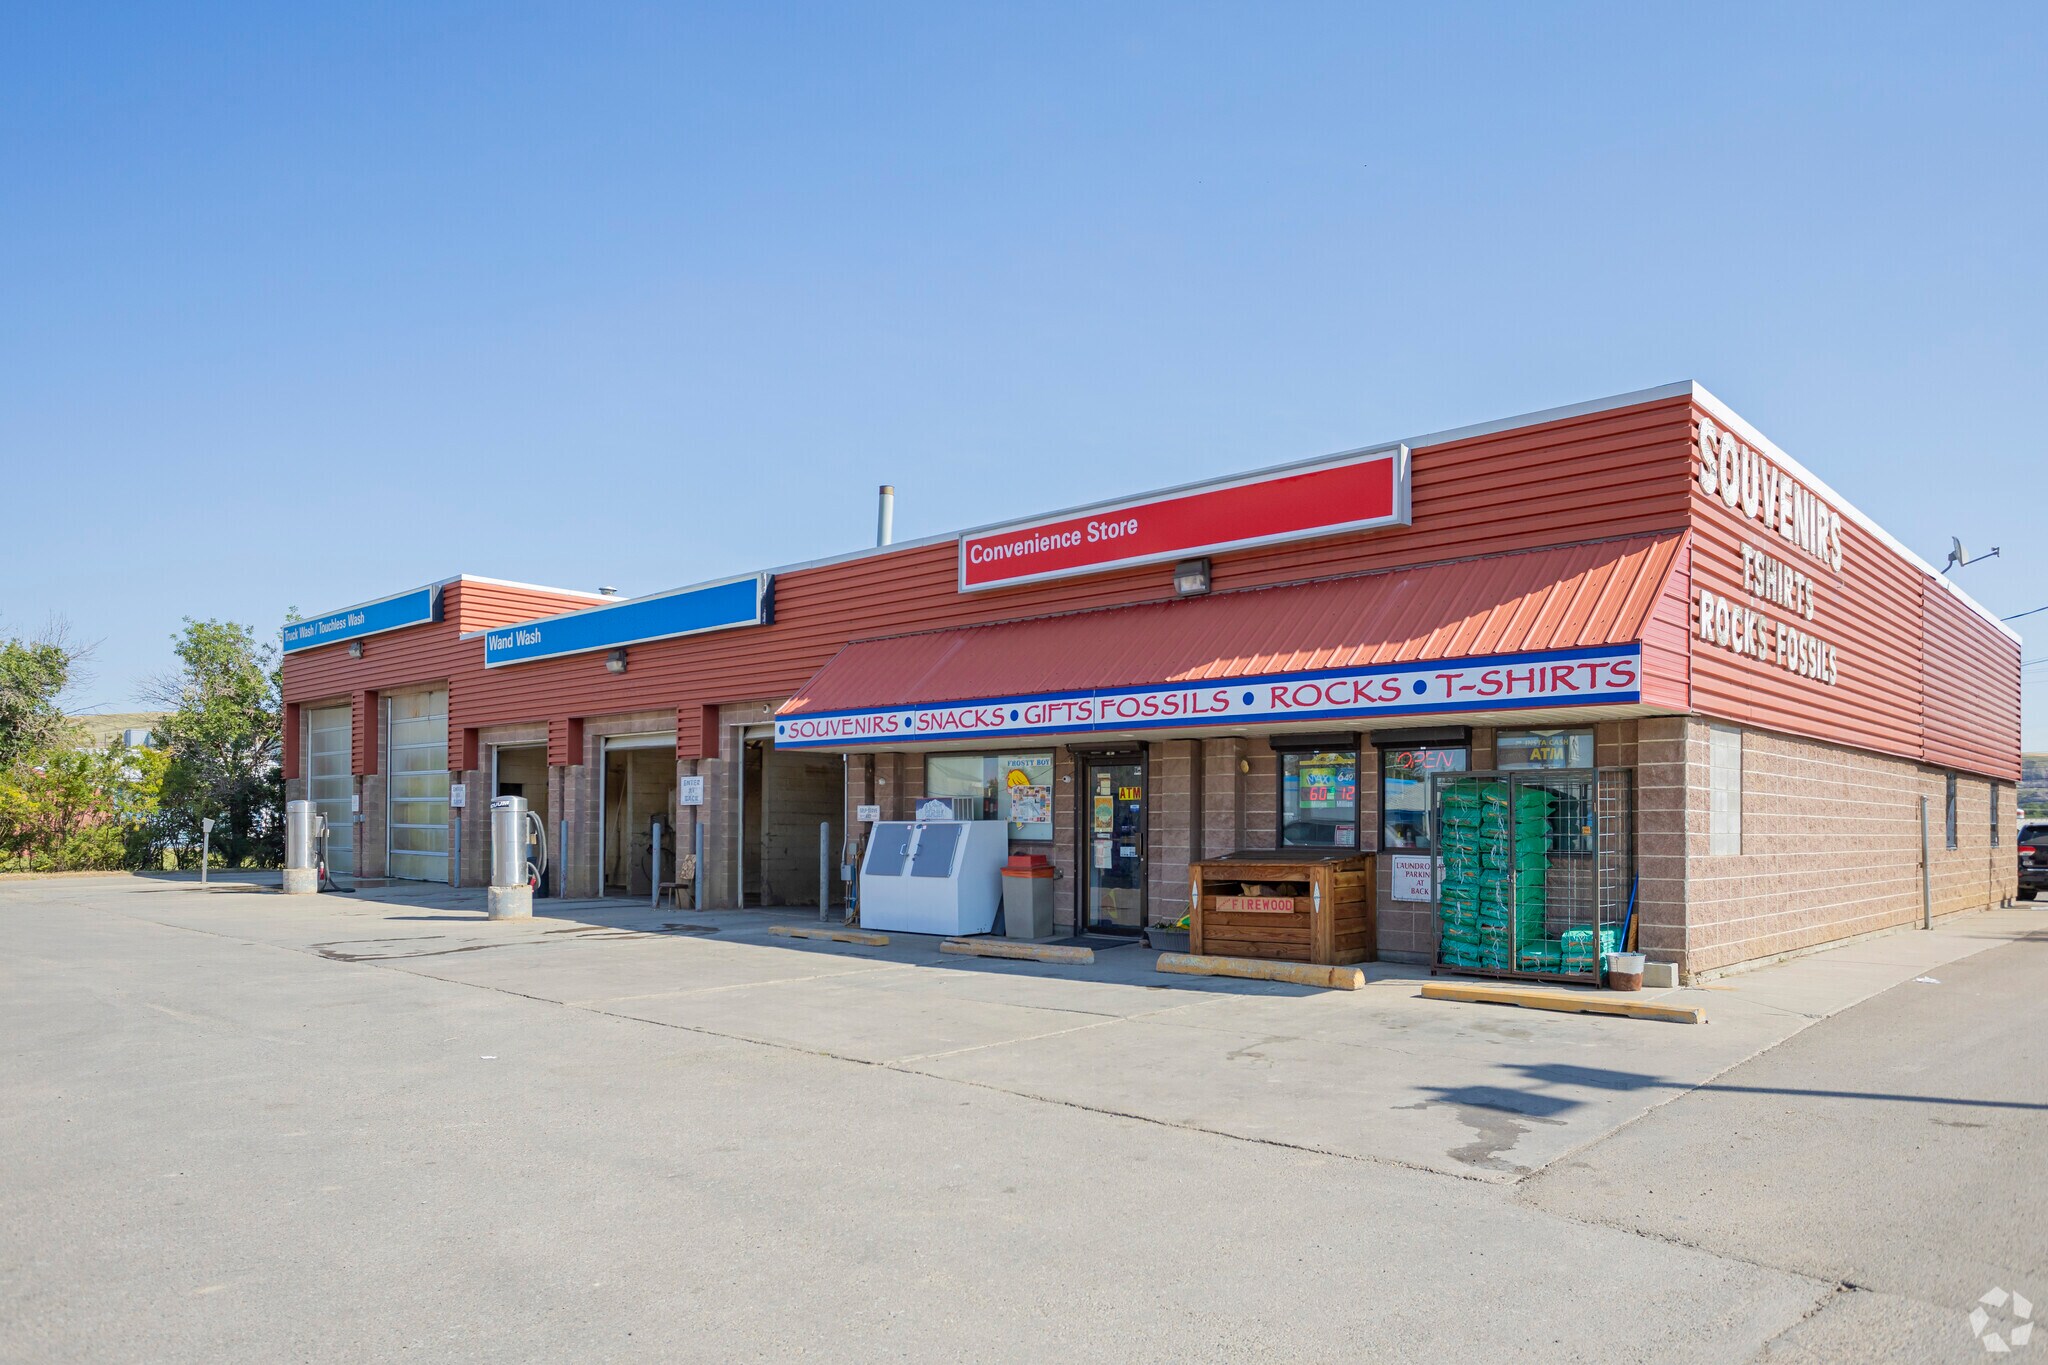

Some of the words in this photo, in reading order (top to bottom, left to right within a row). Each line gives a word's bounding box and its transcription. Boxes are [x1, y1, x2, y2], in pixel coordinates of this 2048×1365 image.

[1698, 417, 1842, 572] SOUVENIRS
[970, 530, 1081, 564] Convenience
[1087, 518, 1138, 543] Store
[1740, 541, 1814, 621] TSHIRTS
[284, 630, 298, 642] Truck
[300, 625, 314, 638] Wash
[319, 617, 346, 634] Touchless
[348, 611, 365, 627] Wash
[489, 632, 513, 651] Wand
[516, 627, 541, 646] Wash
[1699, 589, 1768, 661] ROCKS
[1775, 622, 1837, 686] FOSSILS
[788, 715, 899, 738] SOUVENIRS
[916, 707, 1005, 731] SNACKS
[1024, 700, 1093, 724] GIFTS
[1100, 690, 1230, 719] FOSSILS
[1270, 677, 1402, 708] ROCKS
[1435, 659, 1636, 698] T-SHIRTS
[1549, 738, 1569, 746] CASH
[1007, 759, 1034, 767] FROSTY
[1037, 758, 1050, 766] BOY
[1397, 751, 1454, 769] OPEN
[1530, 747, 1564, 760] ATM
[1120, 787, 1141, 799] ATM
[1309, 786, 1327, 801] 60
[1341, 786, 1355, 801] 12
[1396, 862, 1444, 870] LAUNDROAT
[1231, 899, 1292, 911] FIREWOOD
